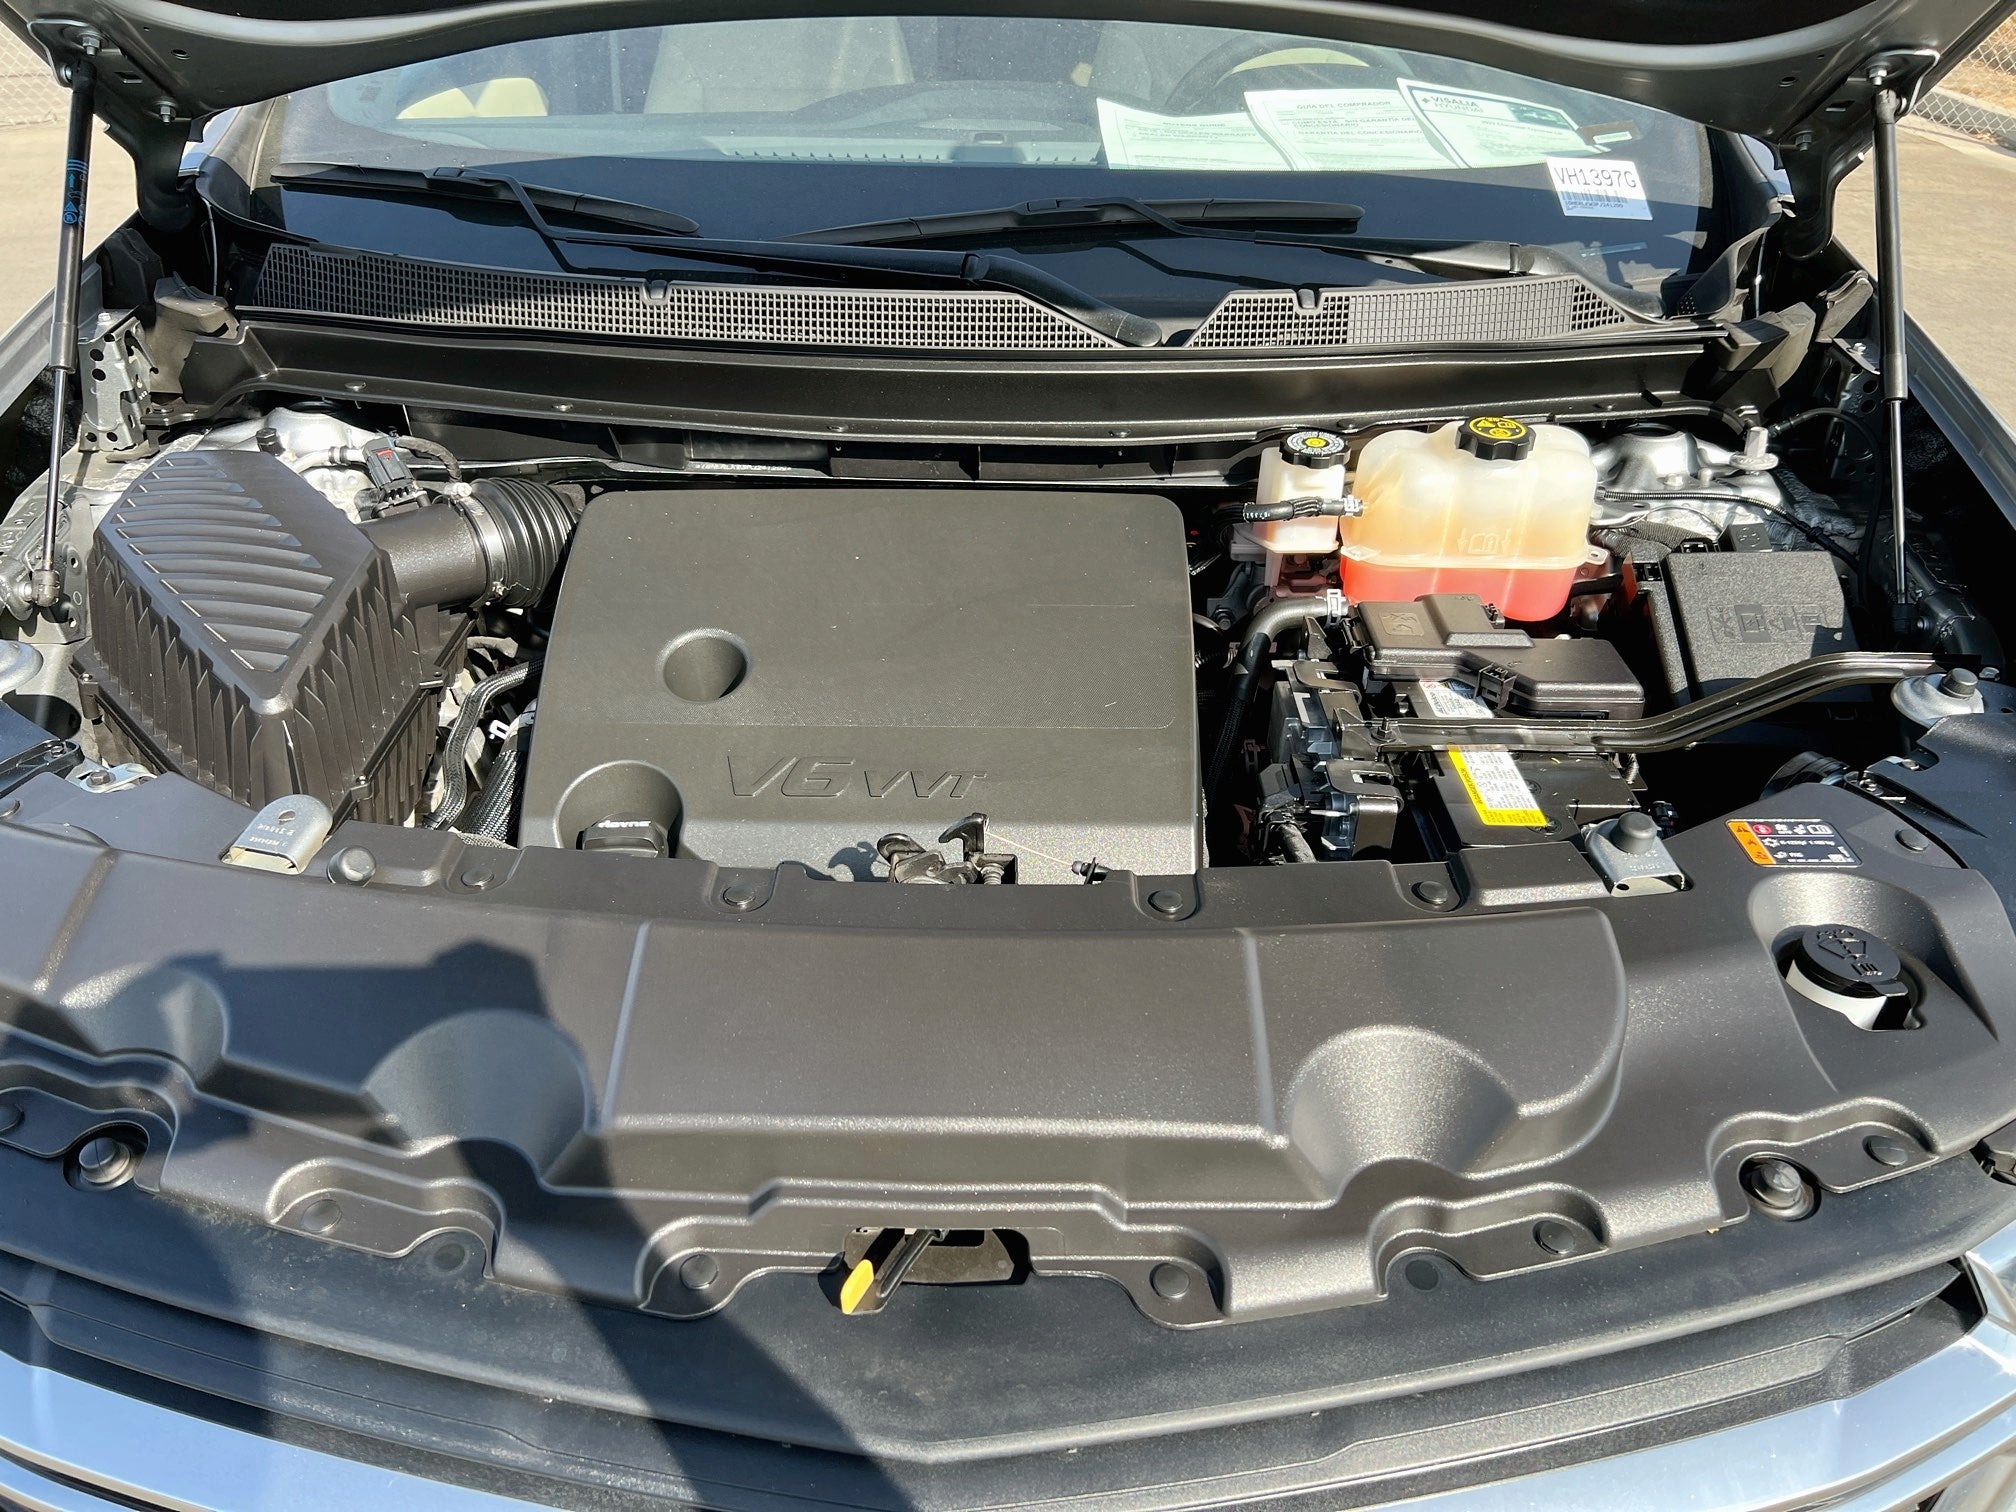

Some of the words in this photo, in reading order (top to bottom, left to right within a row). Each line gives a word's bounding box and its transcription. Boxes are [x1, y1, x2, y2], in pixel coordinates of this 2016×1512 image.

[1430, 96, 1480, 109] VISALIA
[1553, 167, 1637, 188] VH1397G
[727, 755, 856, 798] V6
[863, 769, 988, 799] VVT
